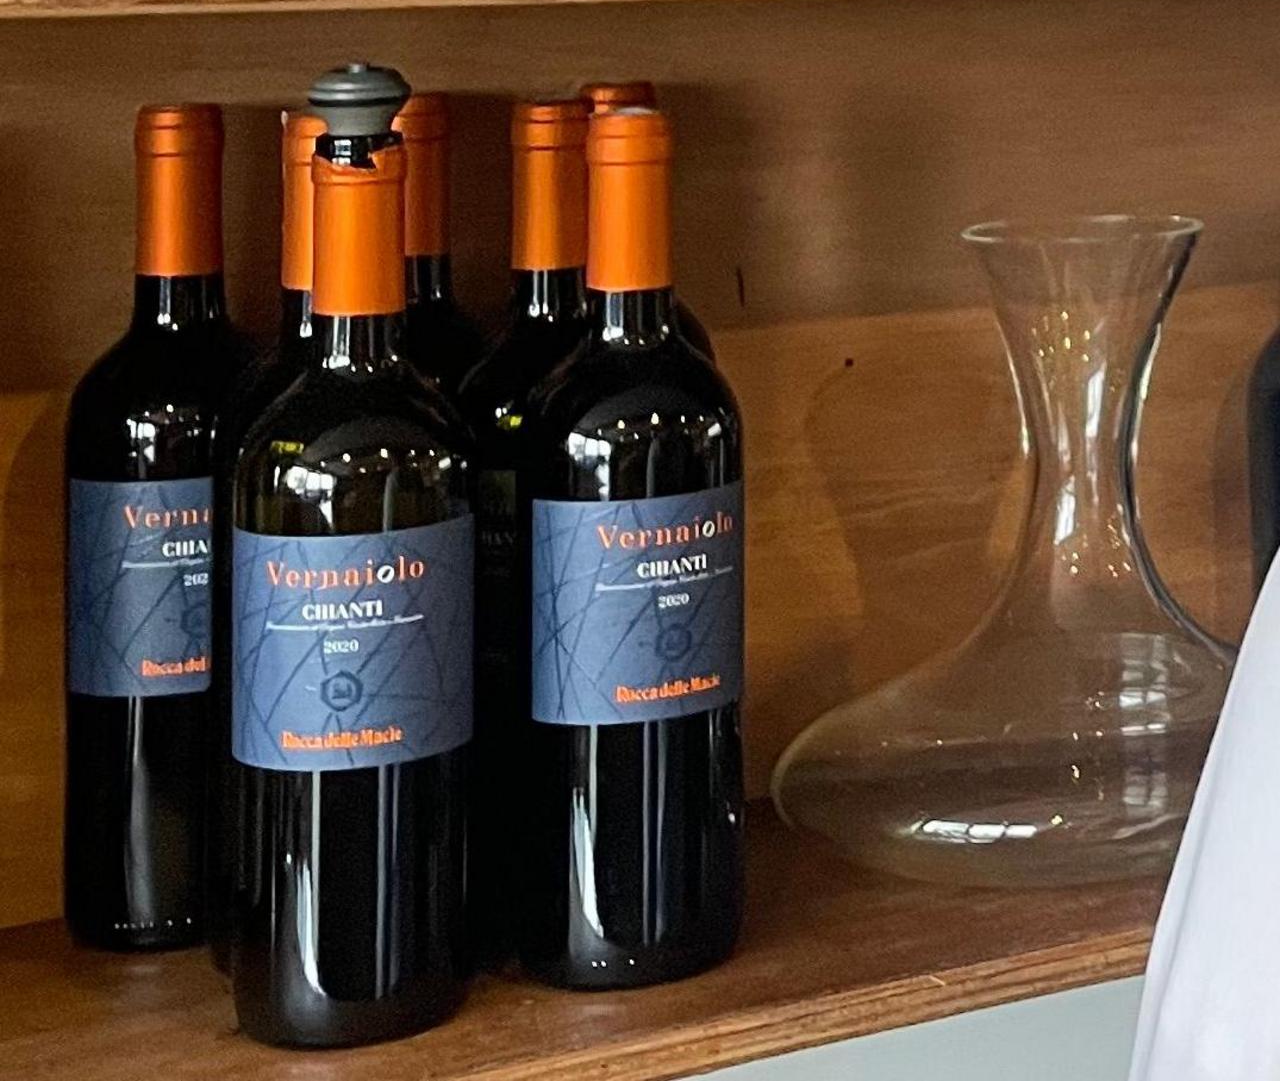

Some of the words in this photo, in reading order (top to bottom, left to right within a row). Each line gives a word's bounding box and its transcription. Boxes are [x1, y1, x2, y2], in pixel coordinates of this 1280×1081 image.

[597, 510, 734, 550] Vernaiolo
[266, 555, 425, 590] Vernaiolo
[635, 552, 708, 579] CHIANTI
[302, 599, 383, 621] CHIANTI
[657, 591, 691, 609] 2020
[322, 638, 360, 654] 2020
